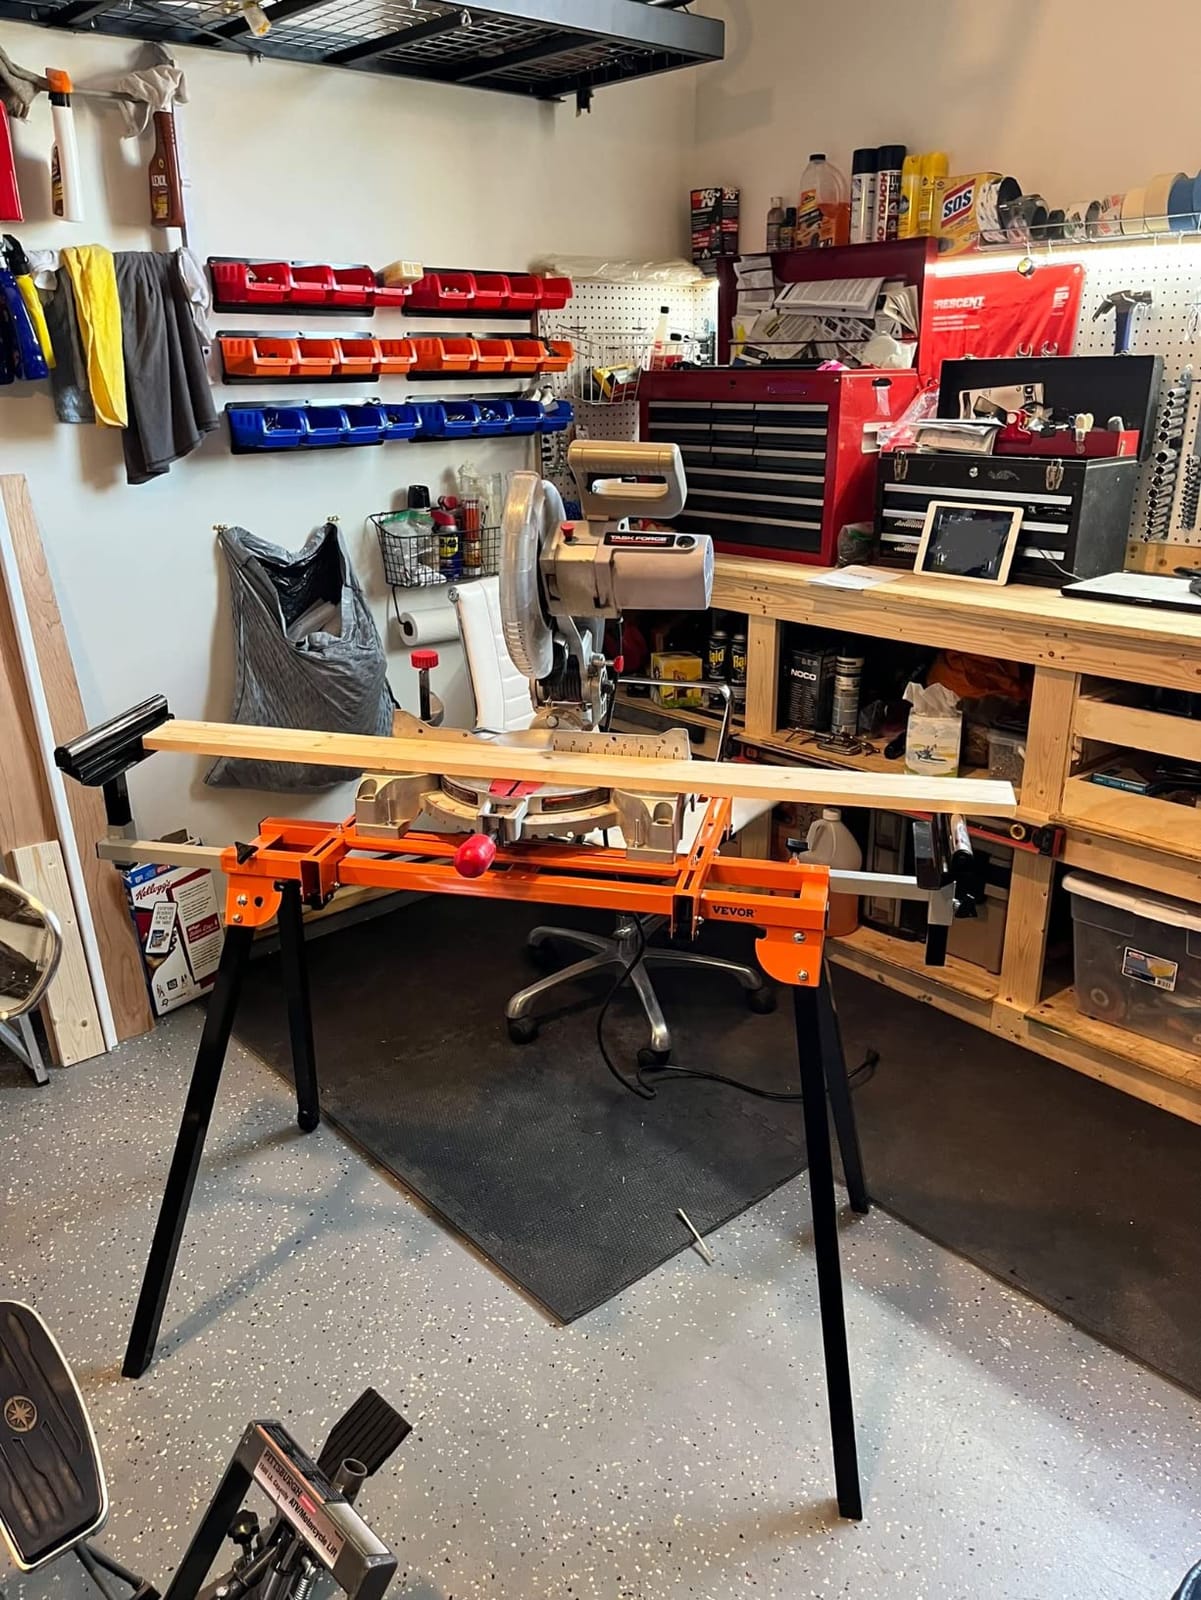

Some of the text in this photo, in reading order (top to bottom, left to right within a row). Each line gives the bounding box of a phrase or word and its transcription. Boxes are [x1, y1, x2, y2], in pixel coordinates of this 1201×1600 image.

[878, 173, 887, 222] TOUCH
[943, 188, 973, 218] SOS
[790, 668, 817, 681] NOCO
[135, 879, 172, 901] Kellogg's
[711, 904, 754, 918] VEVOR
[263, 1449, 303, 1498] PITTSBURGH
[326, 1543, 338, 1557] Lift
